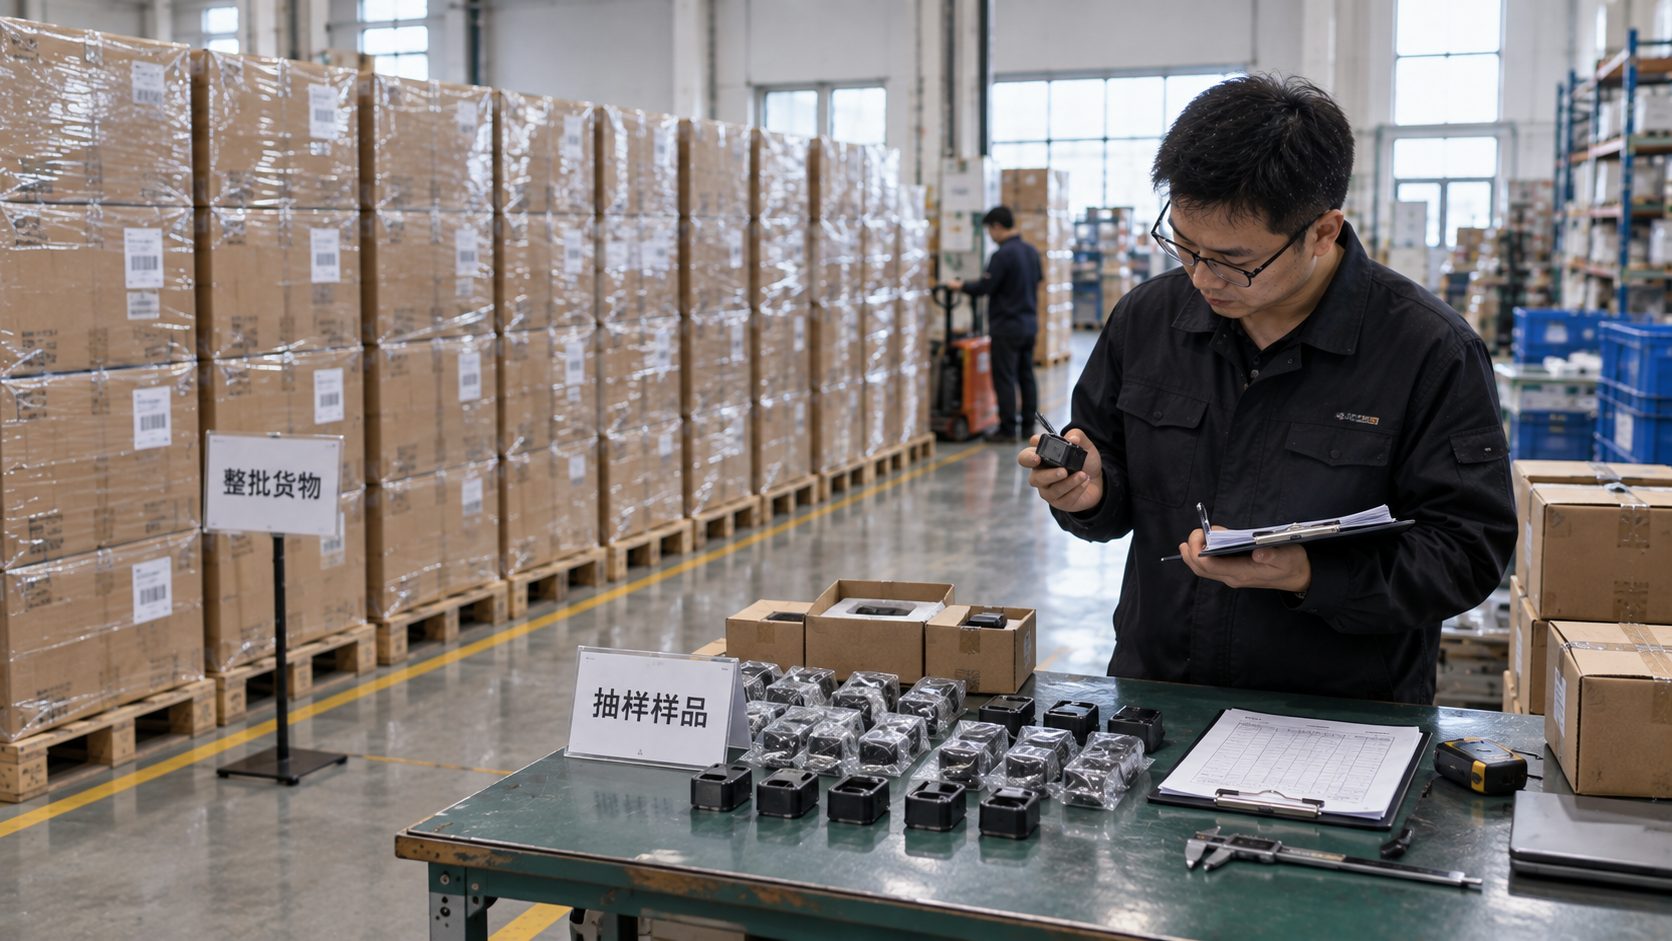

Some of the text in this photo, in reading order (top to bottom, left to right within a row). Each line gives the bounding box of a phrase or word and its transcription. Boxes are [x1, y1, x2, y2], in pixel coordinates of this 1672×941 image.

[223, 467, 322, 500] 整批货物
[592, 687, 708, 728] 抽样样品
